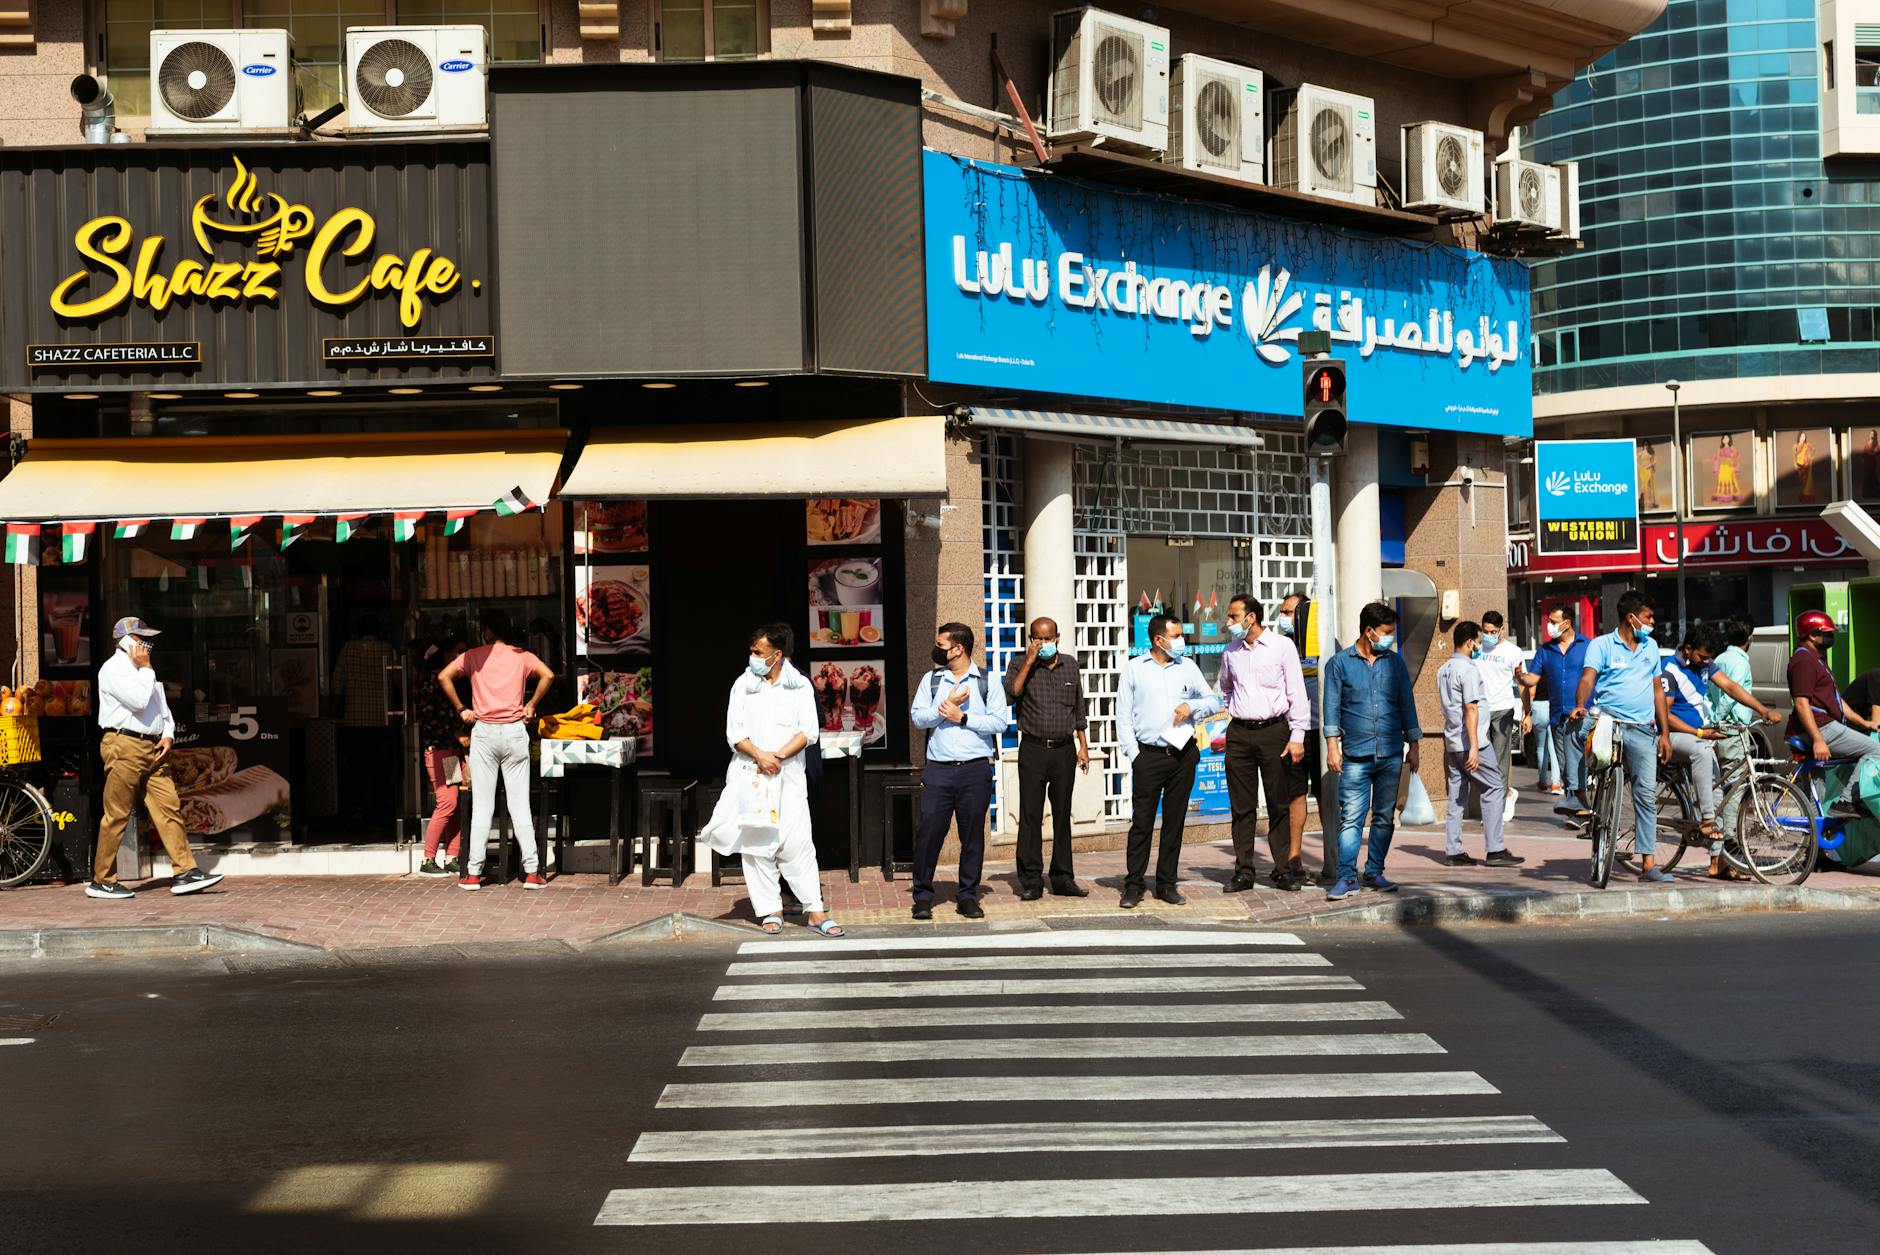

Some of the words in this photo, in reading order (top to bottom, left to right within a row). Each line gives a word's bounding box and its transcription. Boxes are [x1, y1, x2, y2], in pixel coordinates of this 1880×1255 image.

[246, 66, 273, 75] Carrier
[443, 61, 471, 71] Carrier
[50, 215, 281, 317] Shazz
[953, 235, 1050, 301] LuLu
[1058, 251, 1232, 335] Exchange
[34, 349, 81, 361] SHAZZ
[84, 347, 158, 360] CAFETERIA
[161, 346, 193, 359] L.L.C
[1573, 470, 1601, 481] LuLu
[1574, 482, 1629, 495] Exchange
[1547, 521, 1615, 532] WESTERN
[1569, 531, 1615, 541] UNION
[228, 706, 260, 741] 5
[261, 732, 279, 740] Dhs
